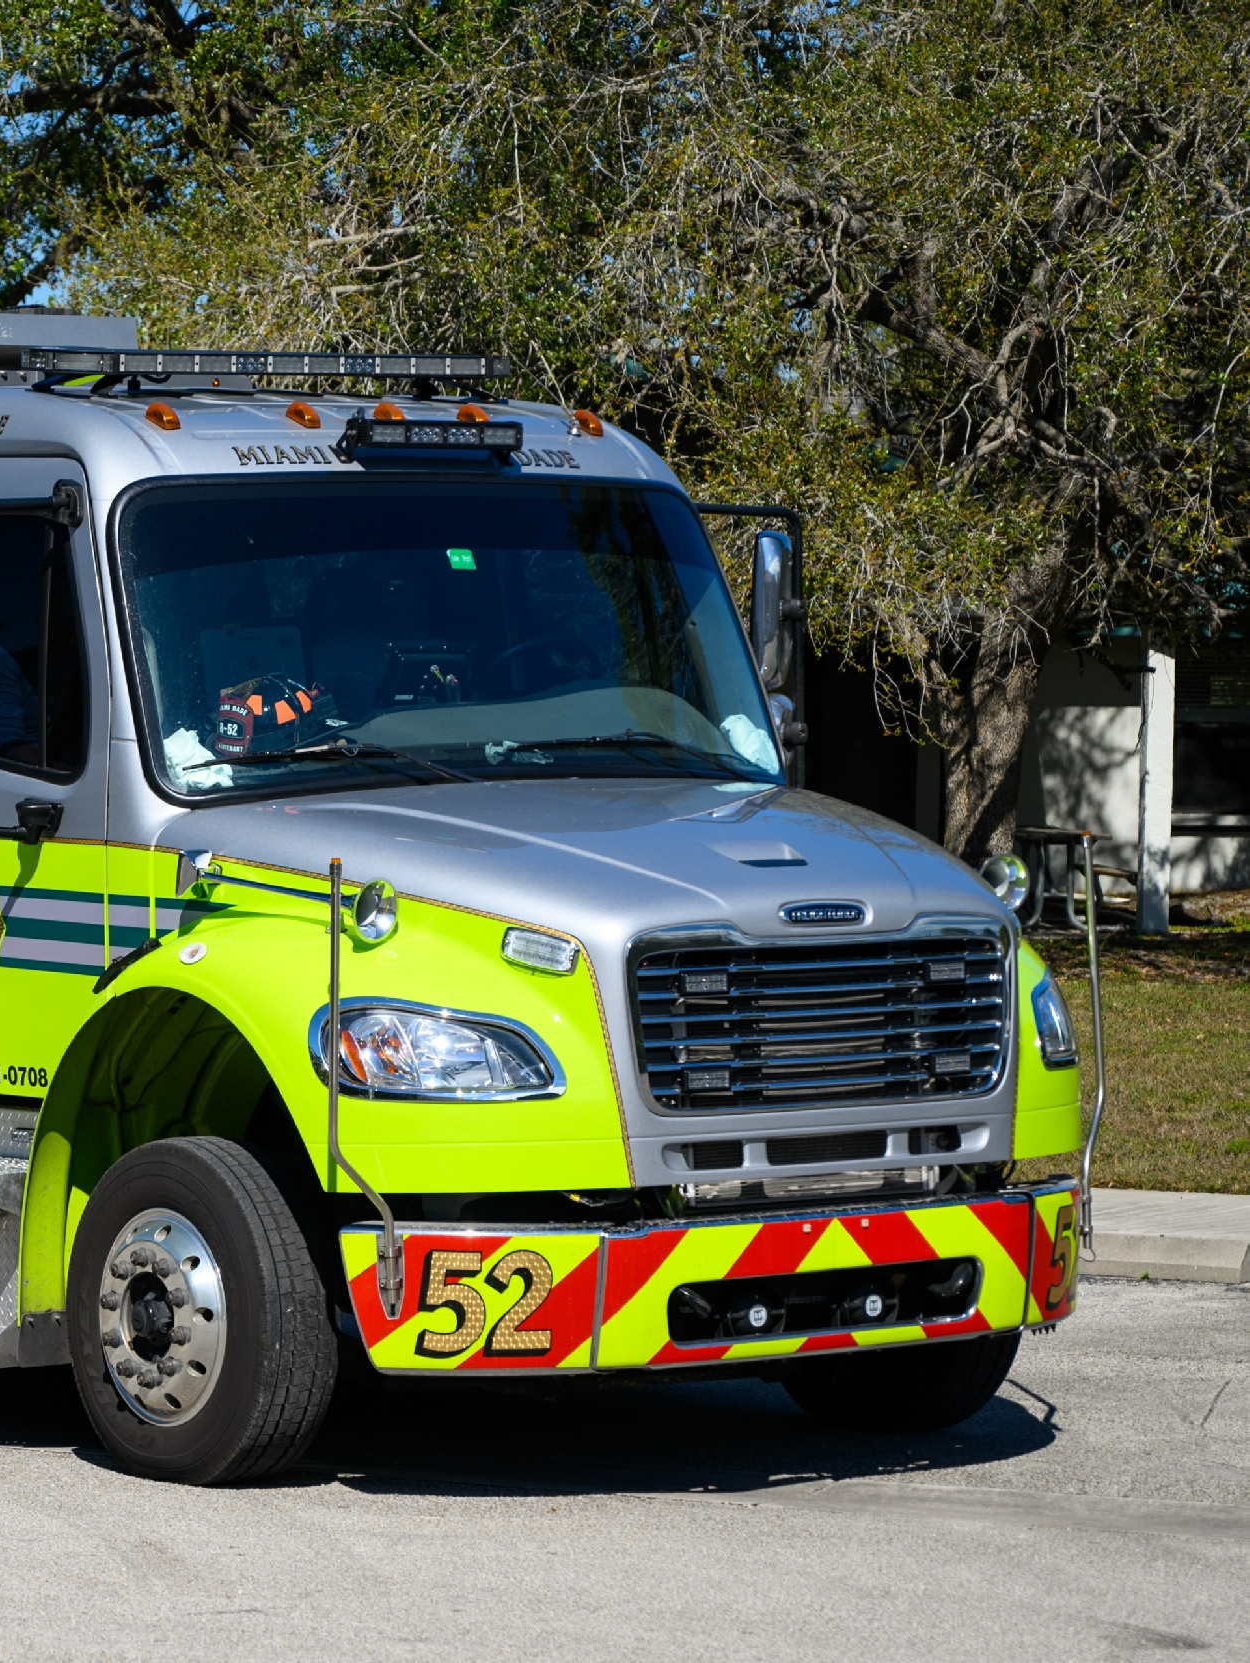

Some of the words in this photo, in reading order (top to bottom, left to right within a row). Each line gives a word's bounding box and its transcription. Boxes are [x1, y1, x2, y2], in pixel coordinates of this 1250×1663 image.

[231, 445, 333, 466] MIAMI
[511, 449, 580, 468] DADE
[232, 705, 248, 716] DADE
[414, 1249, 554, 1359] 52
